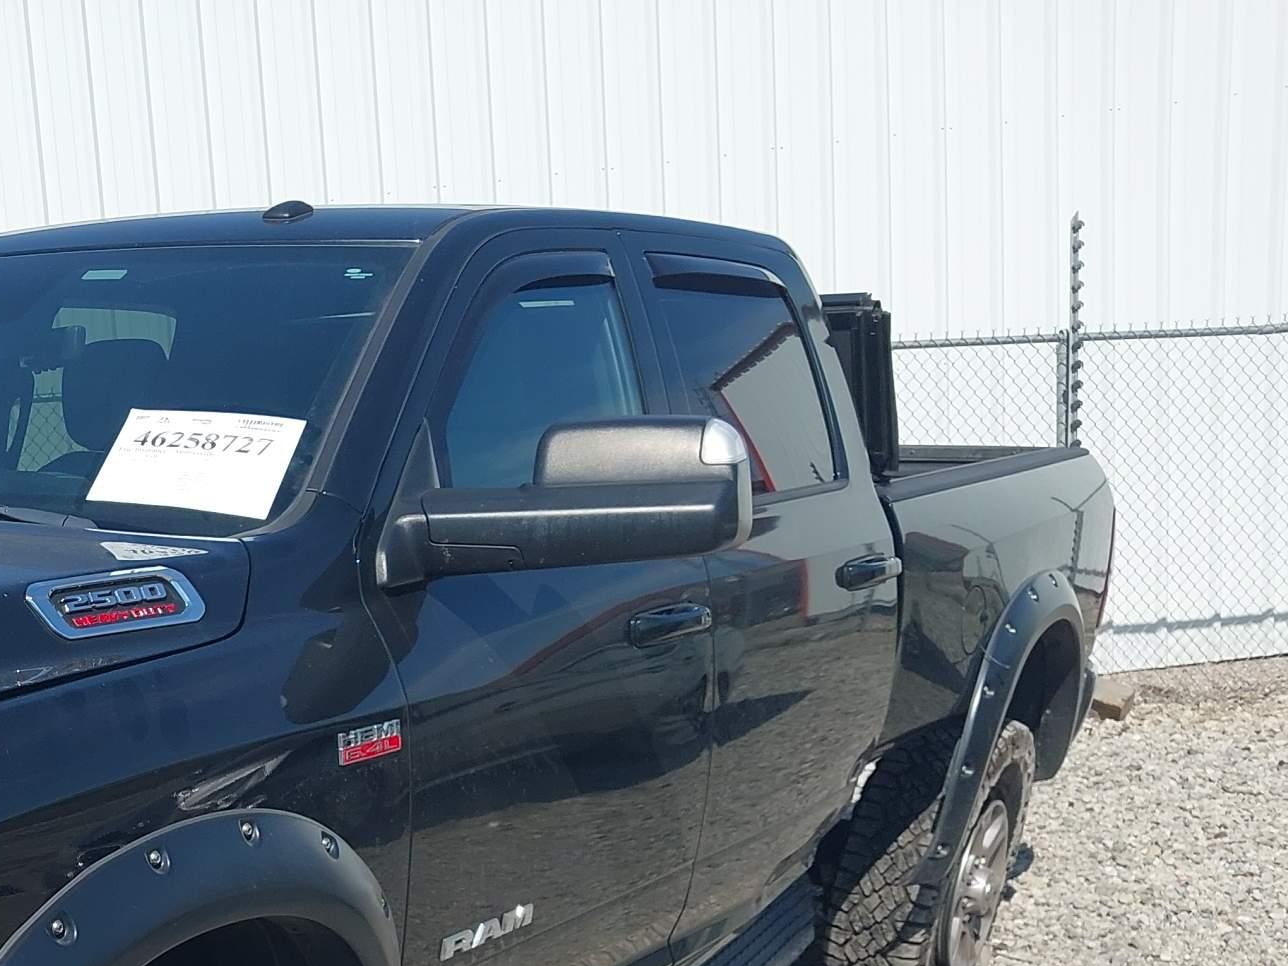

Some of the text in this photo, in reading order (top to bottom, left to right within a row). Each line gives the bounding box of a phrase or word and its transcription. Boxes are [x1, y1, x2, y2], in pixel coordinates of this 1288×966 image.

[133, 429, 275, 456] 46258727
[61, 583, 168, 614] 2500
[439, 903, 534, 962] RAM
